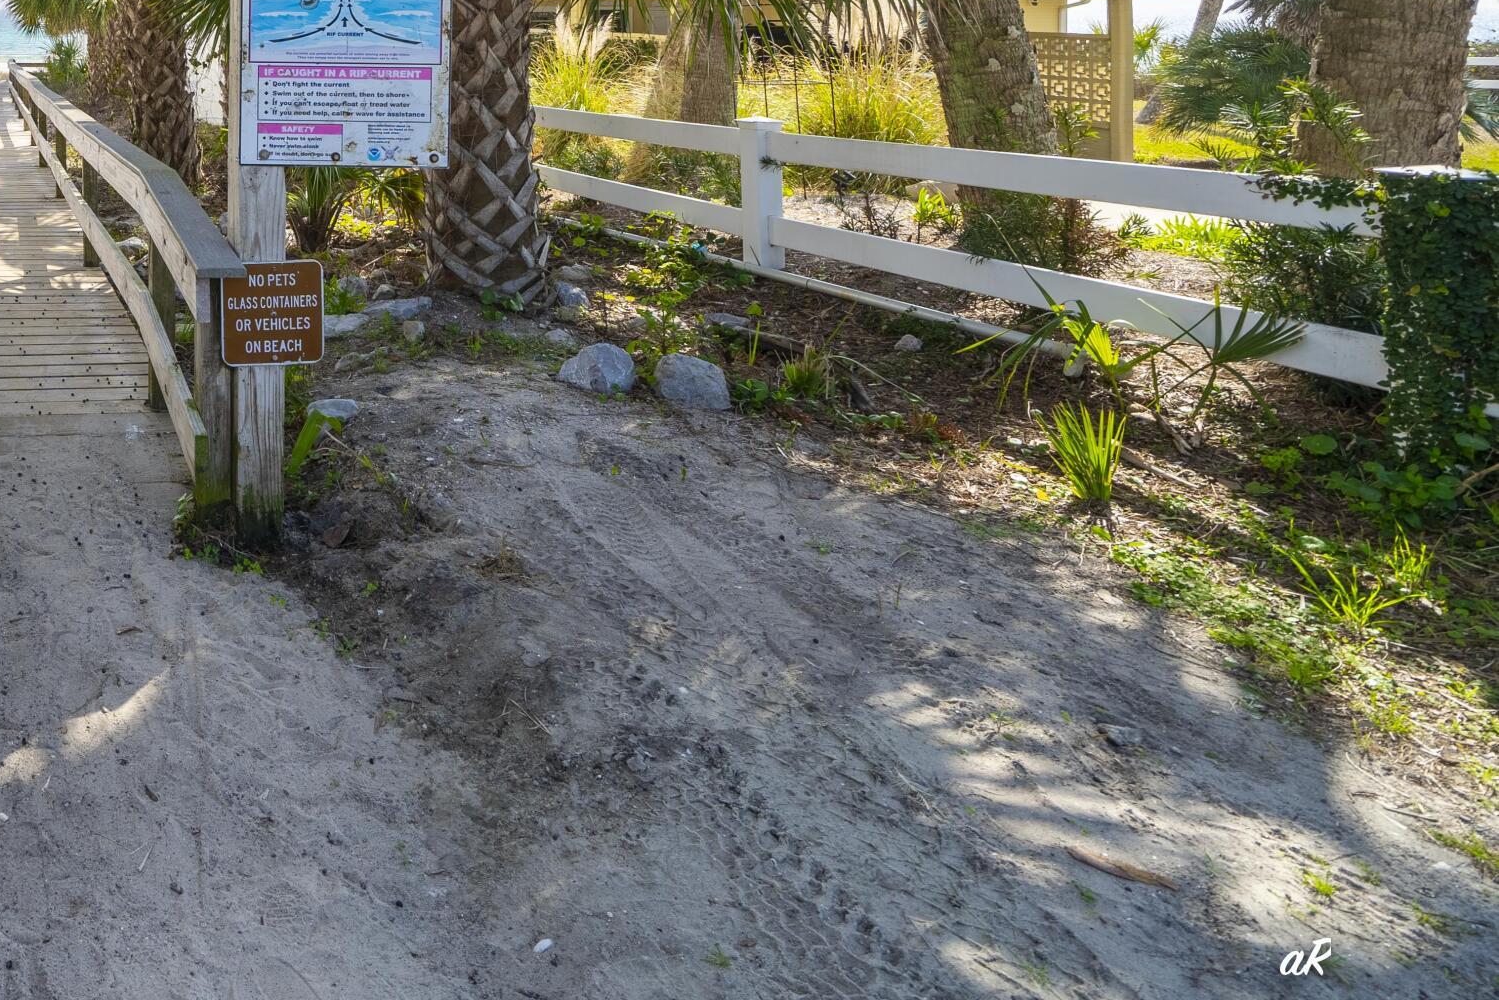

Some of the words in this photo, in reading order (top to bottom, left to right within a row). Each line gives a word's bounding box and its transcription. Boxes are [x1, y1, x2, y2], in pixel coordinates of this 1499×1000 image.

[264, 68, 274, 76] IF
[277, 69, 322, 77] CAUGHT
[325, 69, 335, 77] IN
[371, 70, 421, 78] CURRENT
[248, 275, 264, 287] NO
[268, 273, 296, 286] PETS
[228, 297, 257, 309] GLASS
[260, 295, 317, 308] CONTAINERS
[236, 319, 251, 331] OR
[255, 317, 310, 331] VEHICLES
[245, 341, 261, 353] ON
[264, 339, 301, 352] BEACH
